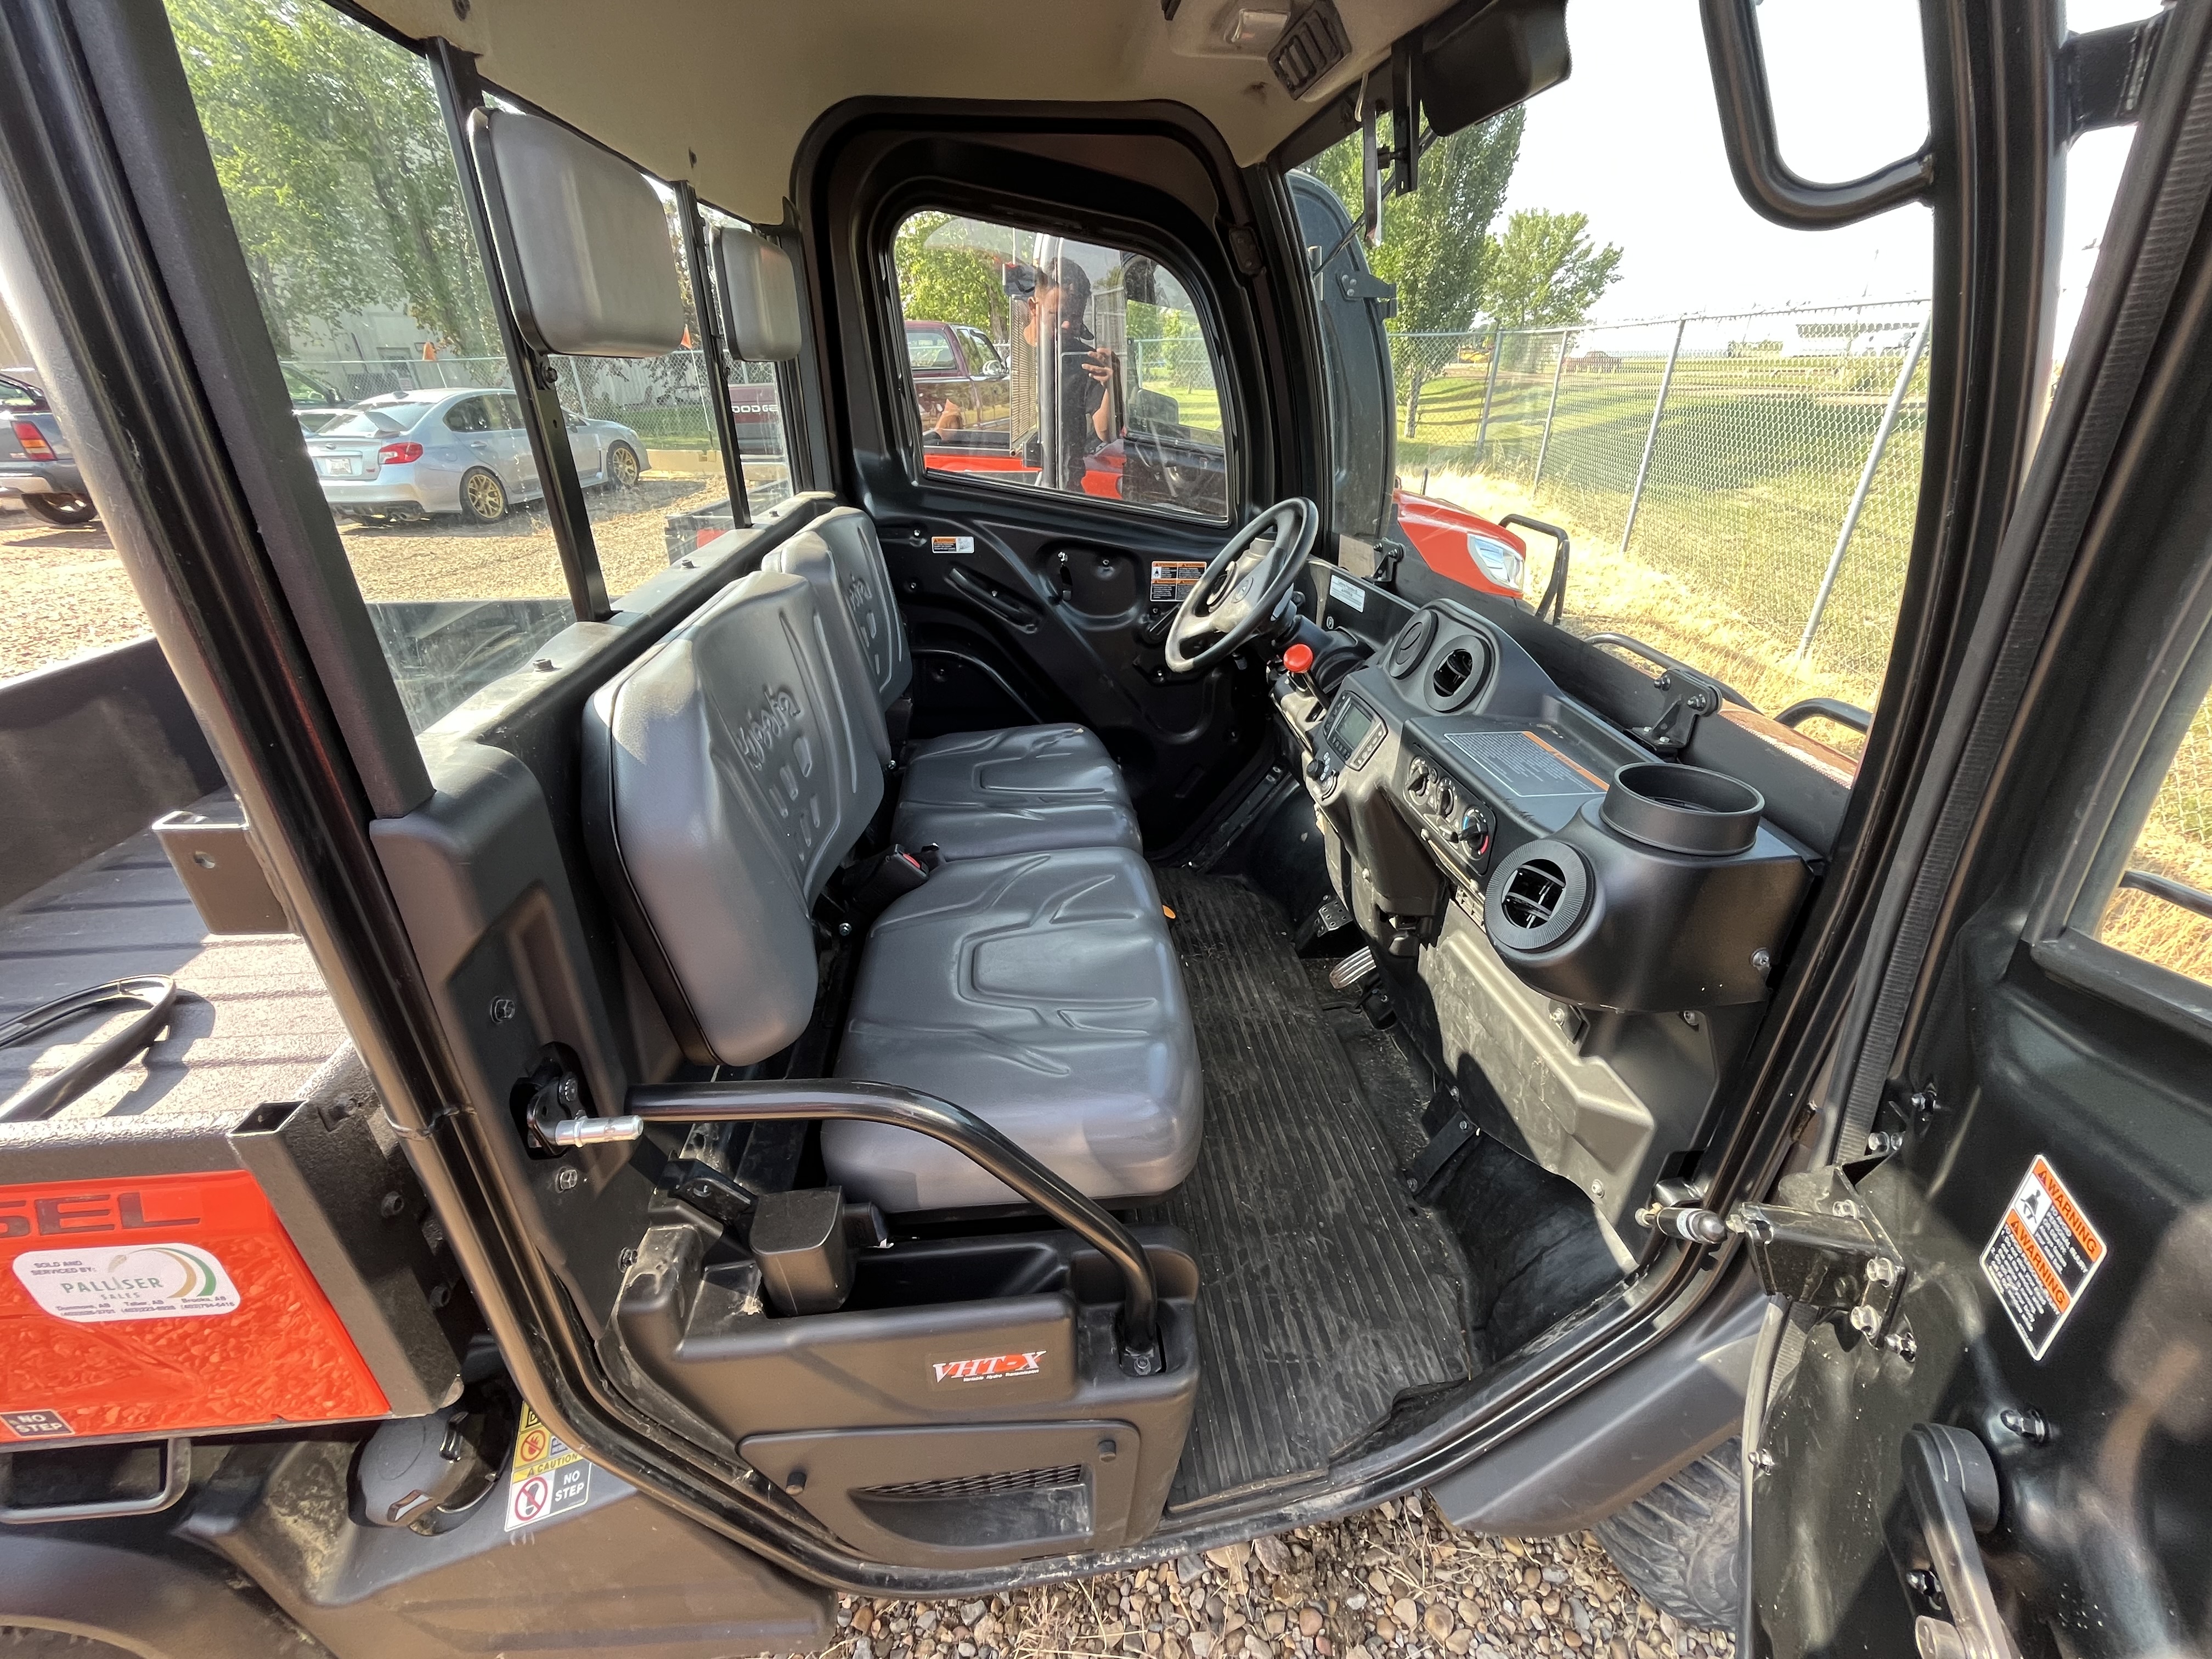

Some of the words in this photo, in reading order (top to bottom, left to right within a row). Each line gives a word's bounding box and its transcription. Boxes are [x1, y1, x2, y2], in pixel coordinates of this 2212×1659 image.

[732, 404, 779, 413] DODGE
[2047, 1180, 2096, 1255] WARNING
[2019, 1232, 2066, 1306] WARNING
[60, 1277, 163, 1294] PALLISER
[933, 1350, 1047, 1383] VHT-X
[15, 1422, 63, 1433] STEP
[16, 1414, 47, 1423] NO
[537, 1454, 578, 1473] CAUTION
[563, 1470, 580, 1486] NO
[555, 1482, 585, 1502] STEP
